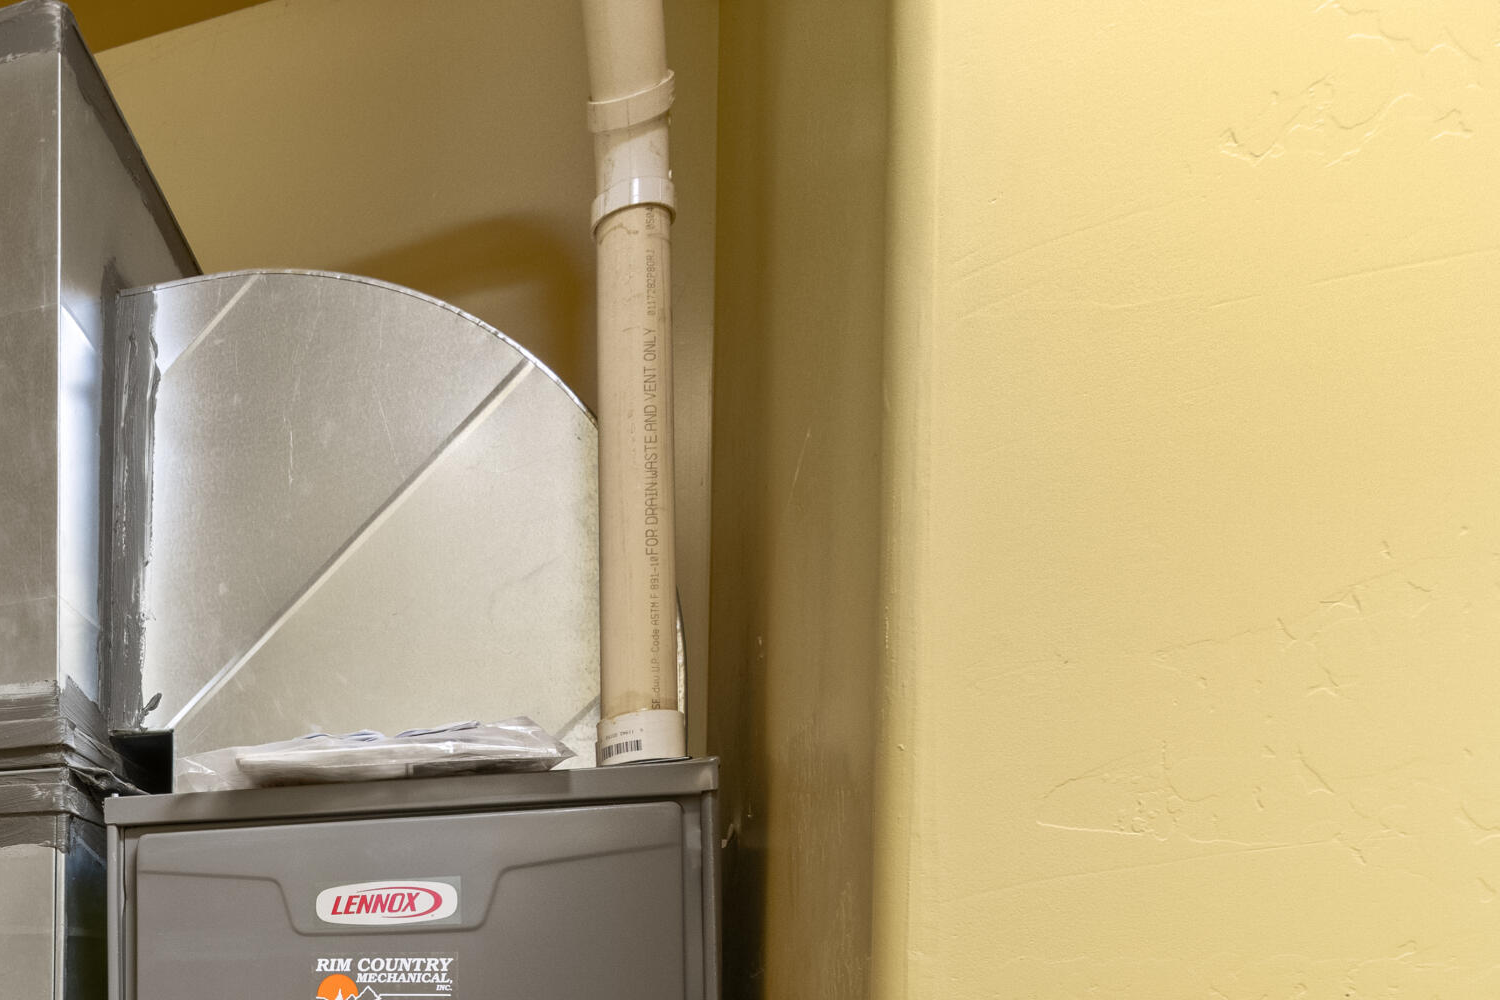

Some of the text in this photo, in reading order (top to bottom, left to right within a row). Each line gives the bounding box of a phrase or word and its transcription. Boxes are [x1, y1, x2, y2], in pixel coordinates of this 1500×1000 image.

[643, 327, 657, 361] ONLY
[643, 366, 657, 399] VENT
[644, 404, 657, 432] AND
[644, 434, 658, 480] WASTE
[644, 482, 658, 525] DRAIN
[645, 529, 658, 556] FOR
[650, 601, 660, 626] ASTM
[650, 629, 660, 653] Code
[331, 892, 420, 916] LENNOX
[315, 957, 454, 972] RIM COUNTRY
[356, 972, 453, 984] MECHANICAL,
